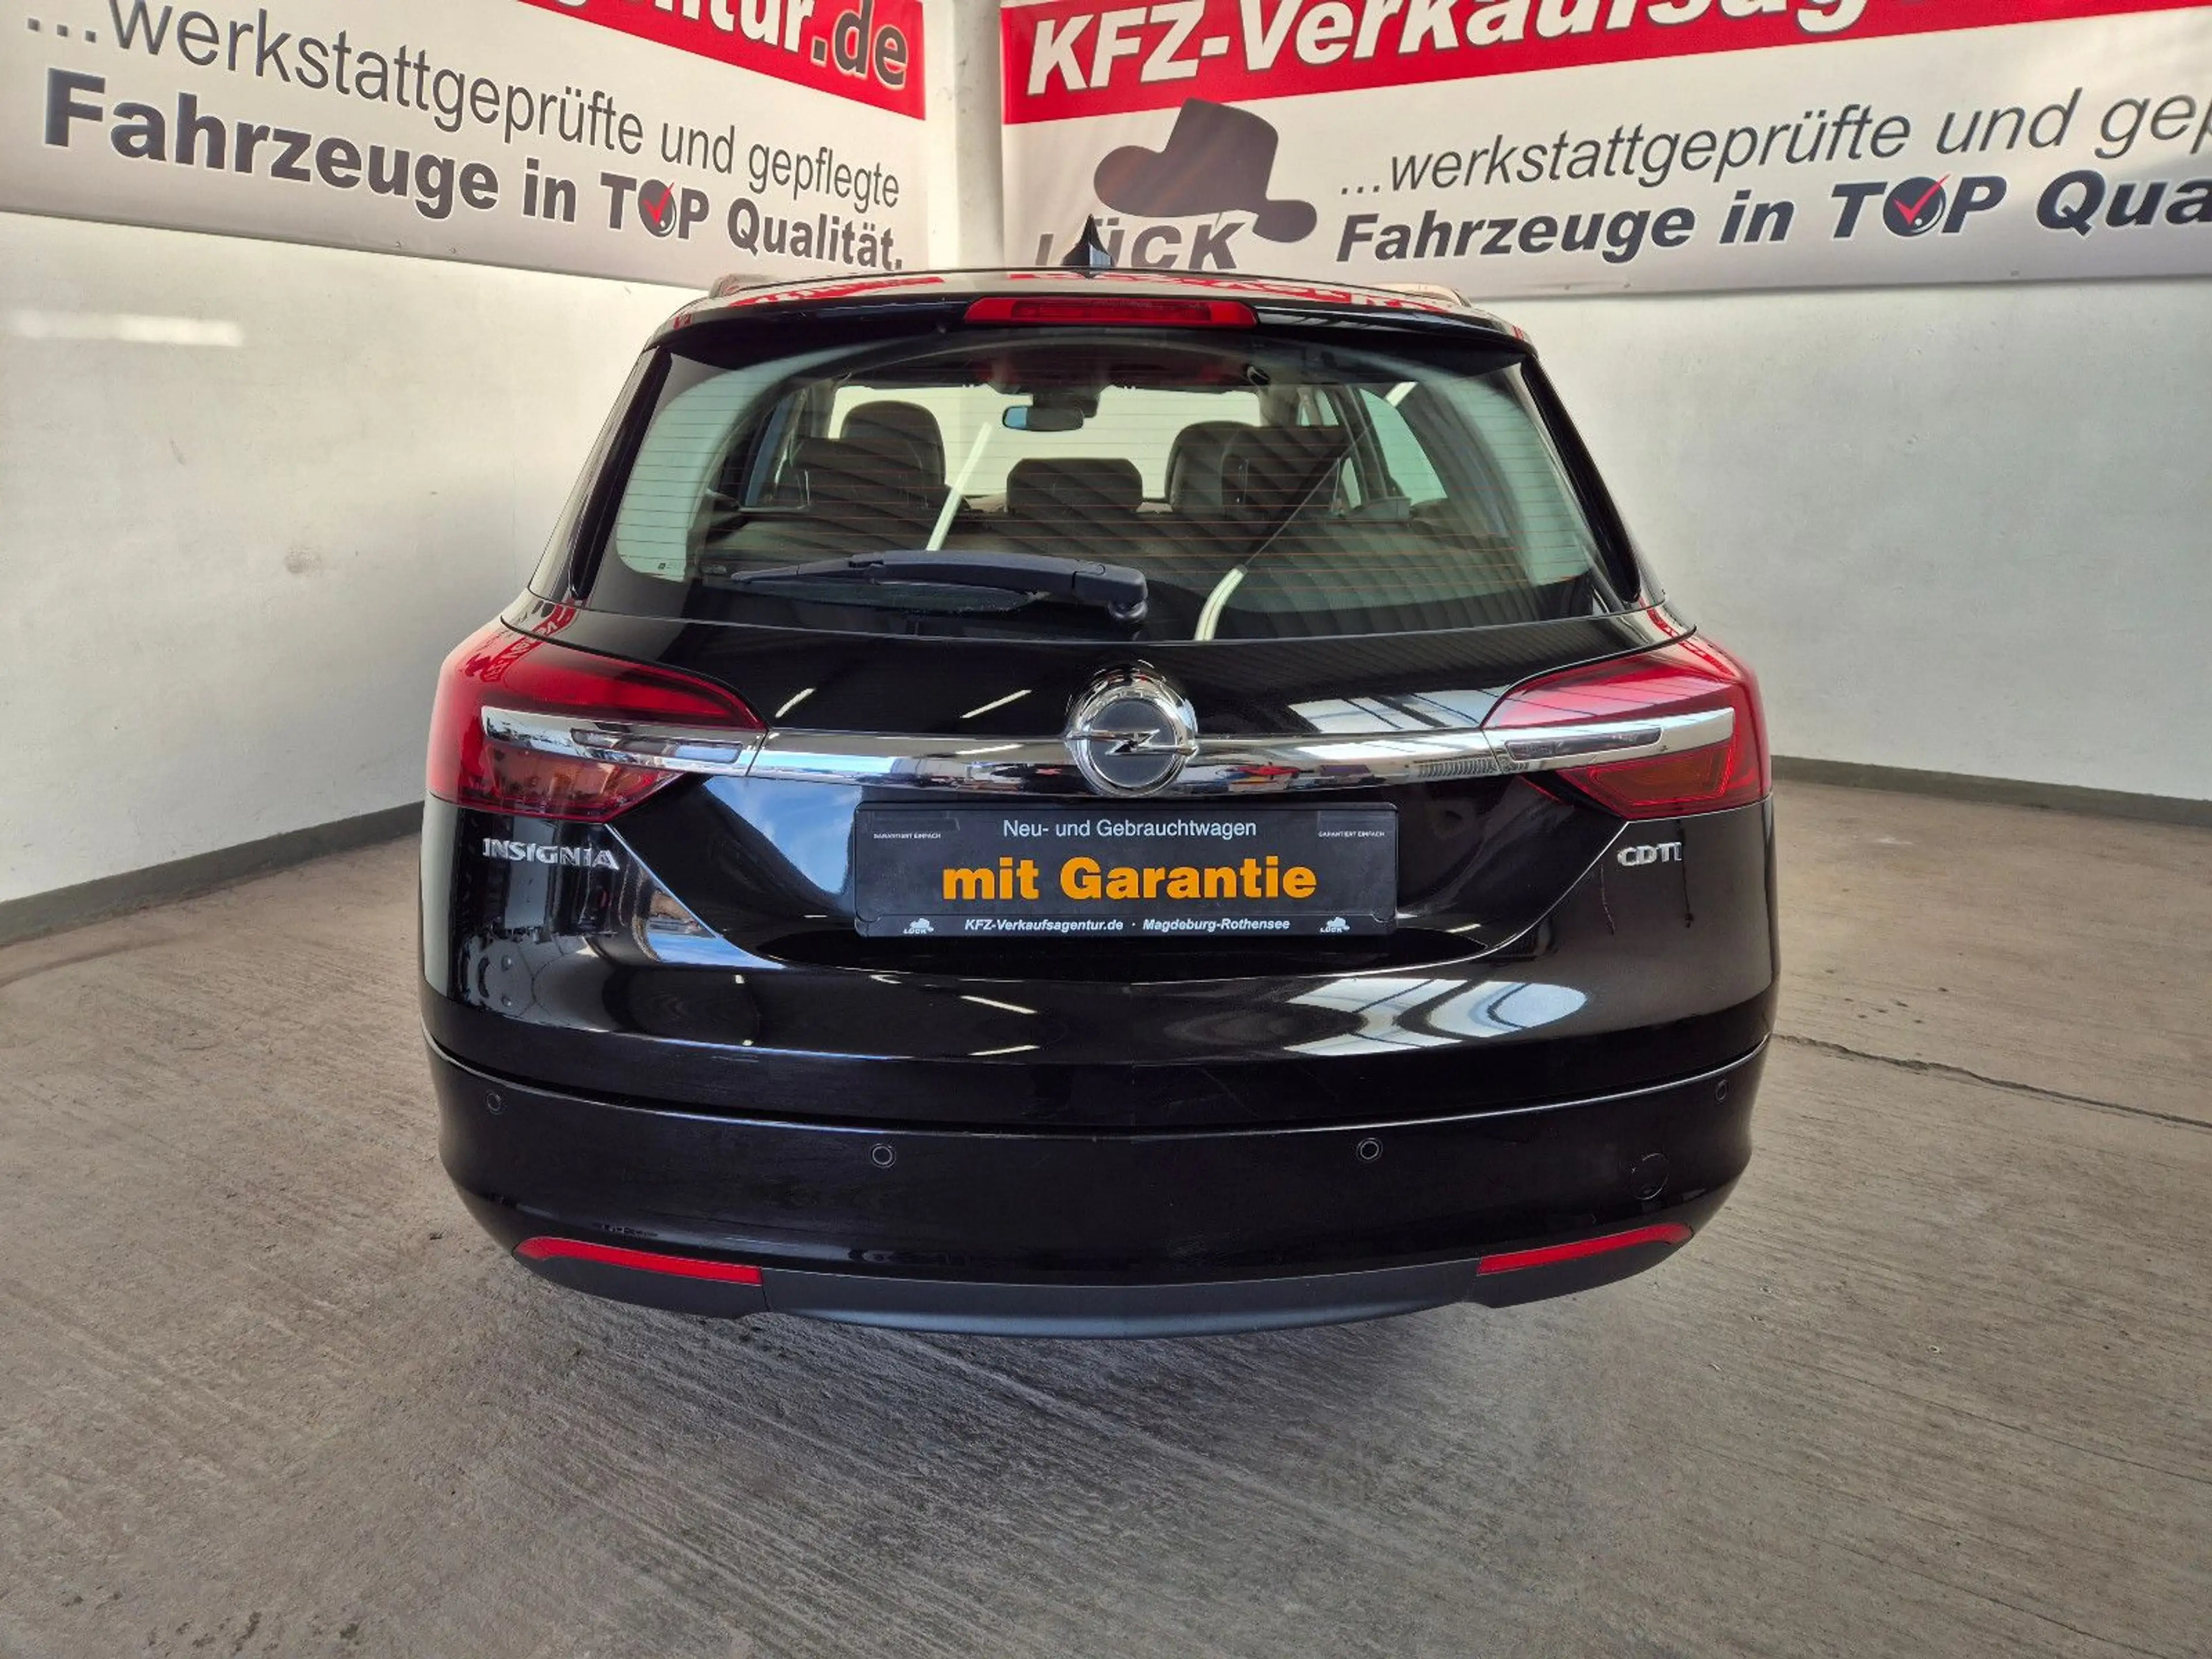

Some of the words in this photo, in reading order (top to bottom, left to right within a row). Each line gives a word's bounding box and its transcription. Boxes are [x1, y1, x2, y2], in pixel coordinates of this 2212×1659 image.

[26, 0, 643, 155] ...werkstattgeprüfte
[662, 123, 735, 174] und
[749, 144, 900, 214] gepflegte
[1340, 104, 1910, 196] ...werkstattgeprüfte
[1936, 88, 2082, 154] und
[44, 67, 499, 219] Fahrzeuge
[524, 158, 576, 223] in
[600, 172, 709, 240] TOP
[728, 198, 903, 271] Qualität.
[1336, 202, 1696, 264] Fahrzeuge
[1719, 189, 1797, 245] in
[1831, 174, 2007, 240] TOP
[1003, 819, 1049, 837] Neu-
[1055, 820, 1091, 837] und
[1096, 819, 1257, 840] Gebrauchtwagen
[482, 837, 620, 871] INSIGNIA
[1617, 841, 1683, 866] CDTI
[942, 856, 1039, 900] mit
[1060, 855, 1317, 900] Garantie
[965, 919, 1124, 933] KFZ-Verkaufsagentur.de
[1143, 918, 1290, 933] Magdeburg-Rothensee
